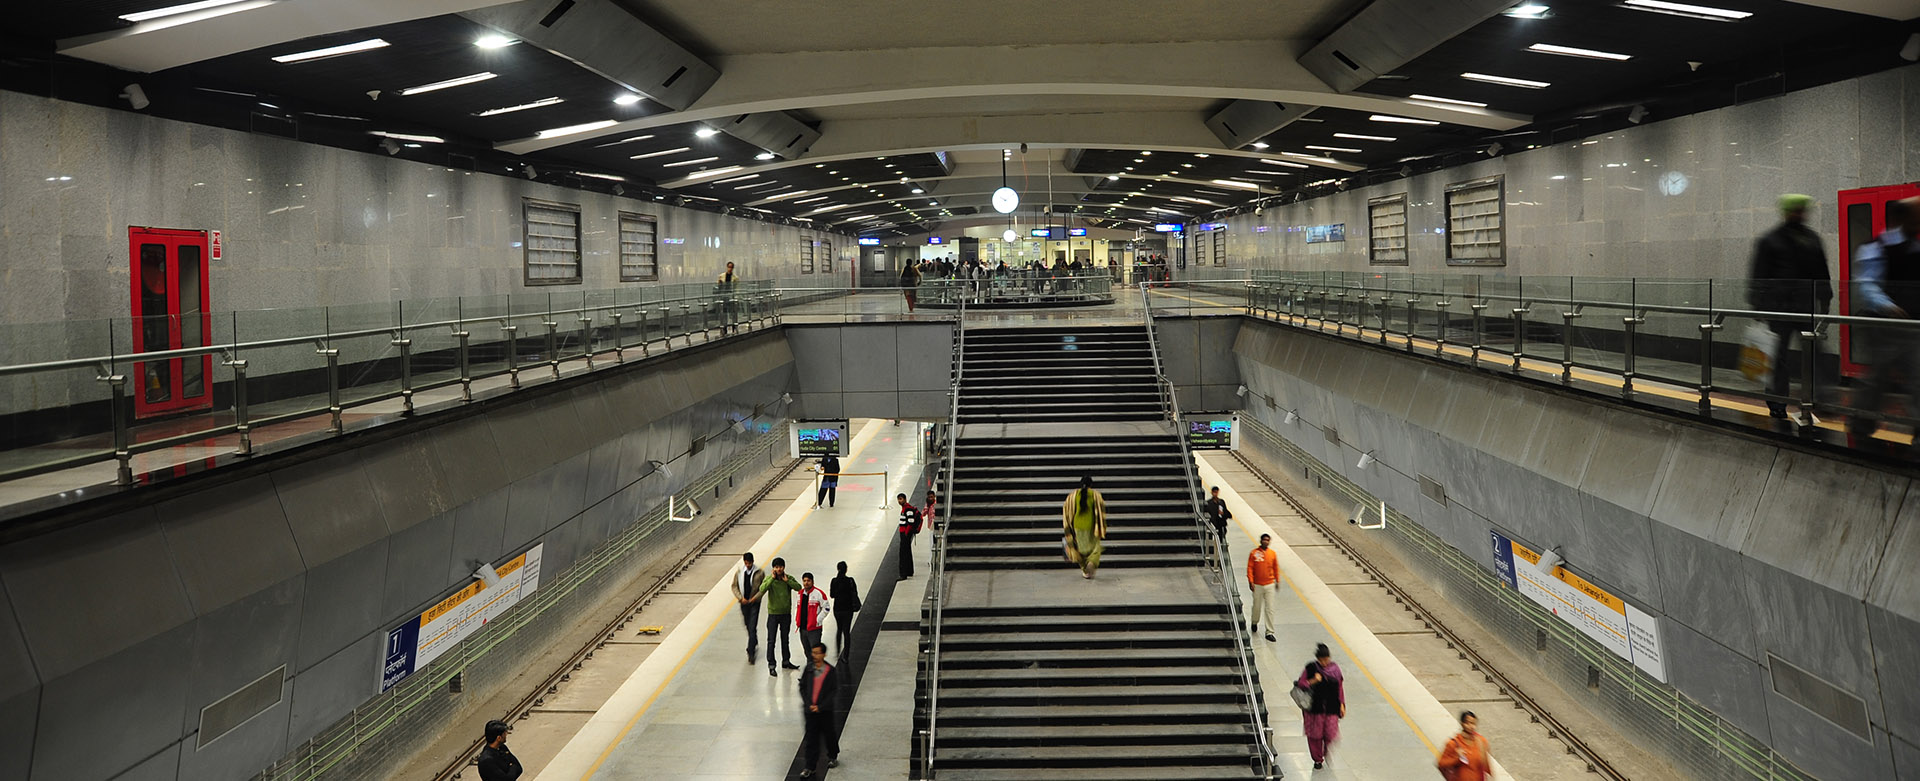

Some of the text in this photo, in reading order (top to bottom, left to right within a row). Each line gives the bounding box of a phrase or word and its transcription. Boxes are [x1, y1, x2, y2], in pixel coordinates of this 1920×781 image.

[1493, 536, 1500, 553] 2
[392, 633, 398, 654] 1
[383, 669, 406, 688] Platform
